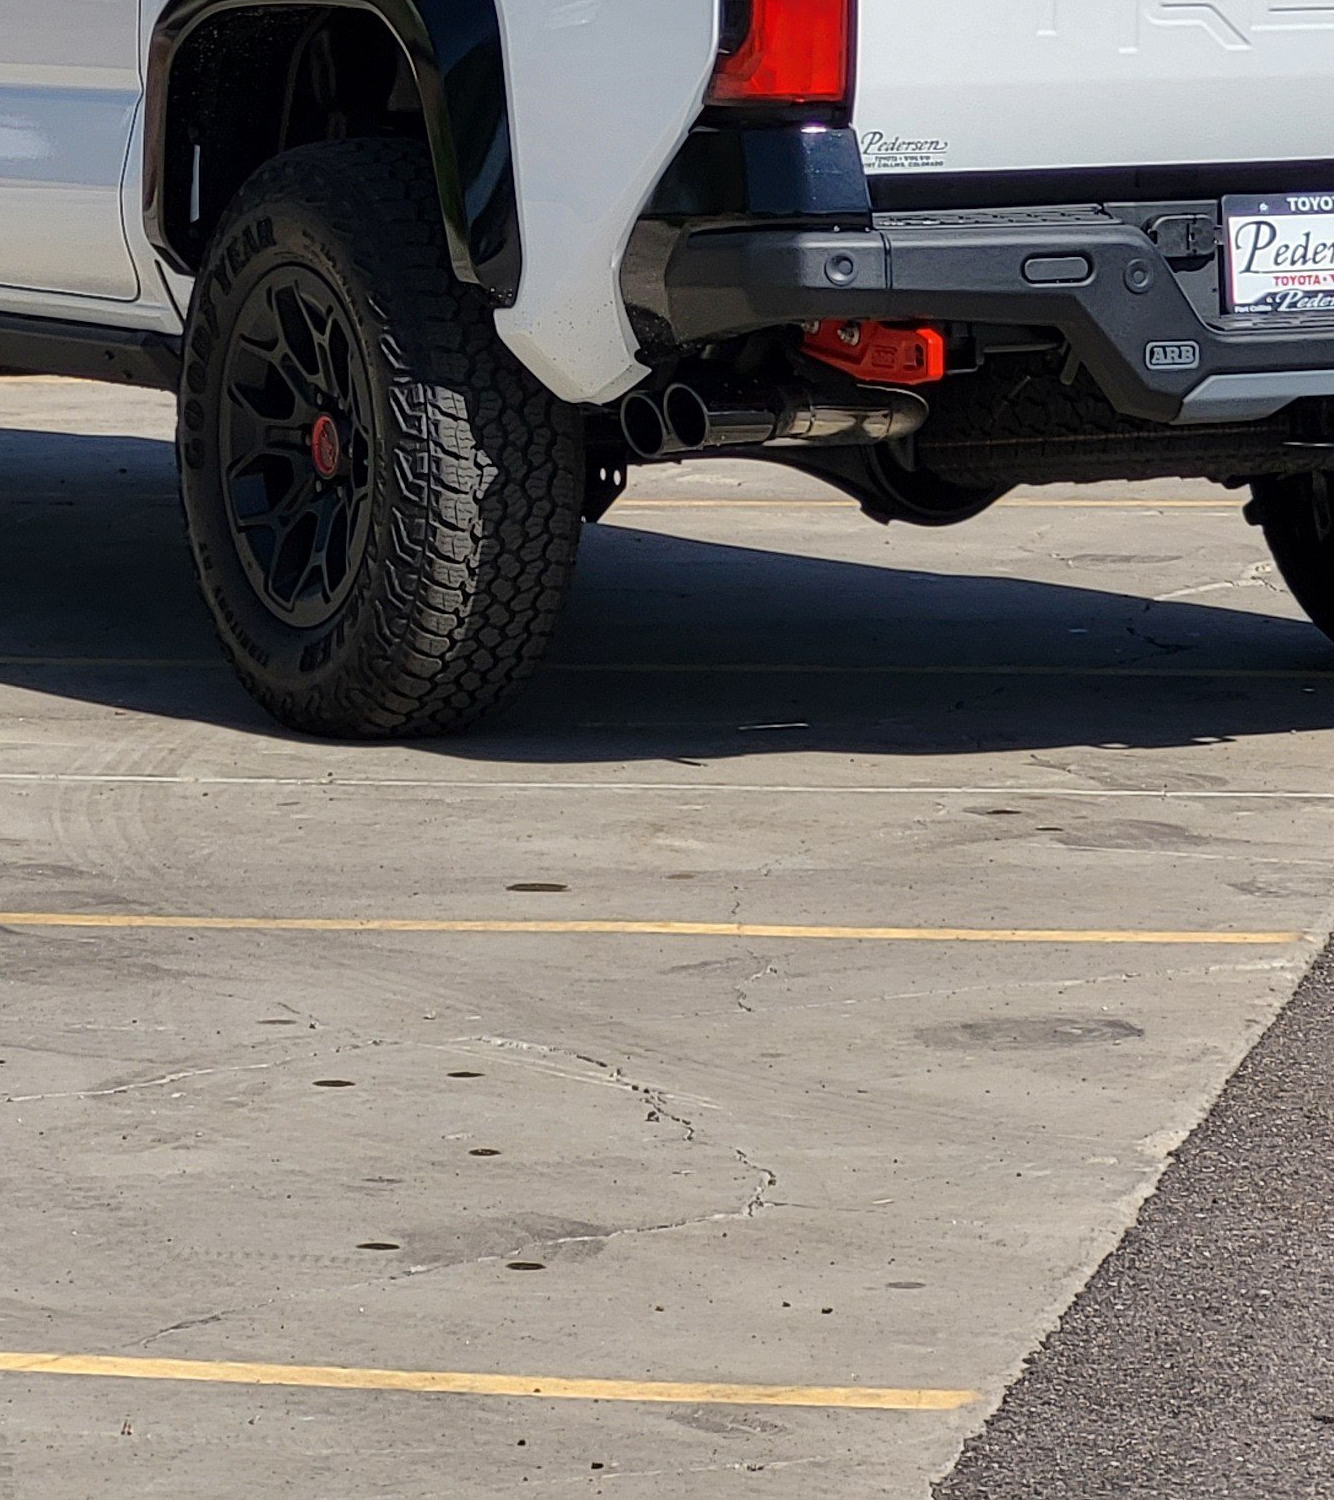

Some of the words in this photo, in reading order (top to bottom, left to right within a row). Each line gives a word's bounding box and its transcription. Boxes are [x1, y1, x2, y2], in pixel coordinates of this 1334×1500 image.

[861, 131, 948, 155] Pedersen
[1273, 275, 1321, 286] TOYOTA
[183, 215, 278, 470] GOODYEAR
[1151, 346, 1195, 365] ARB
